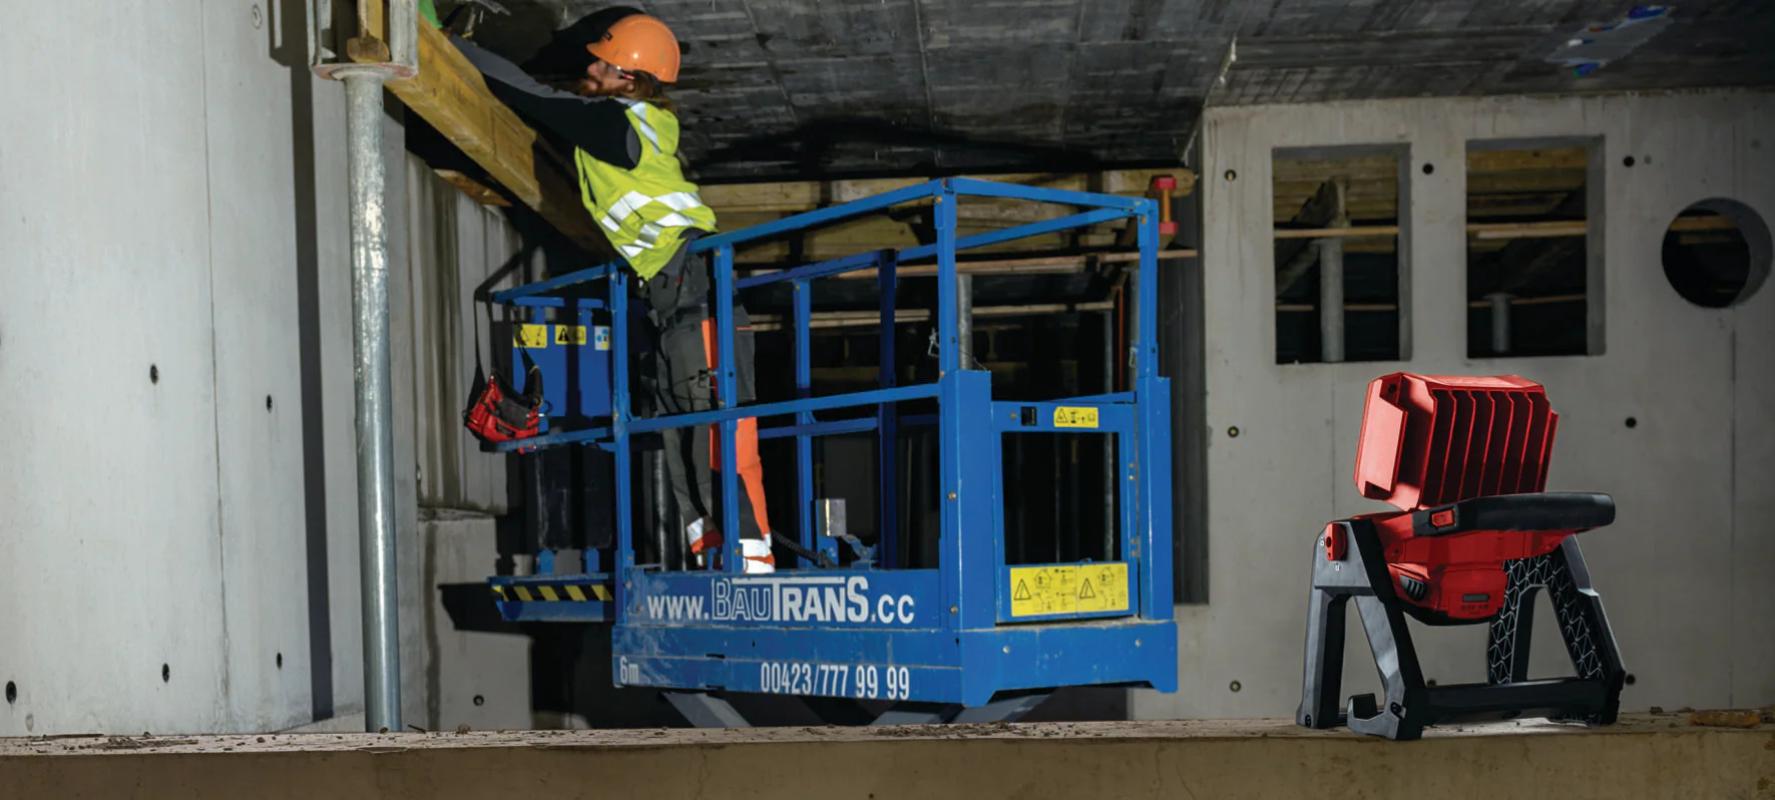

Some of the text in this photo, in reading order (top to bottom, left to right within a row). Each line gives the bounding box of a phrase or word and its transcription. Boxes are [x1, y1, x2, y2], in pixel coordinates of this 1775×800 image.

[619, 656, 640, 685] 6m
[760, 662, 910, 700] 00423/777 99 99
